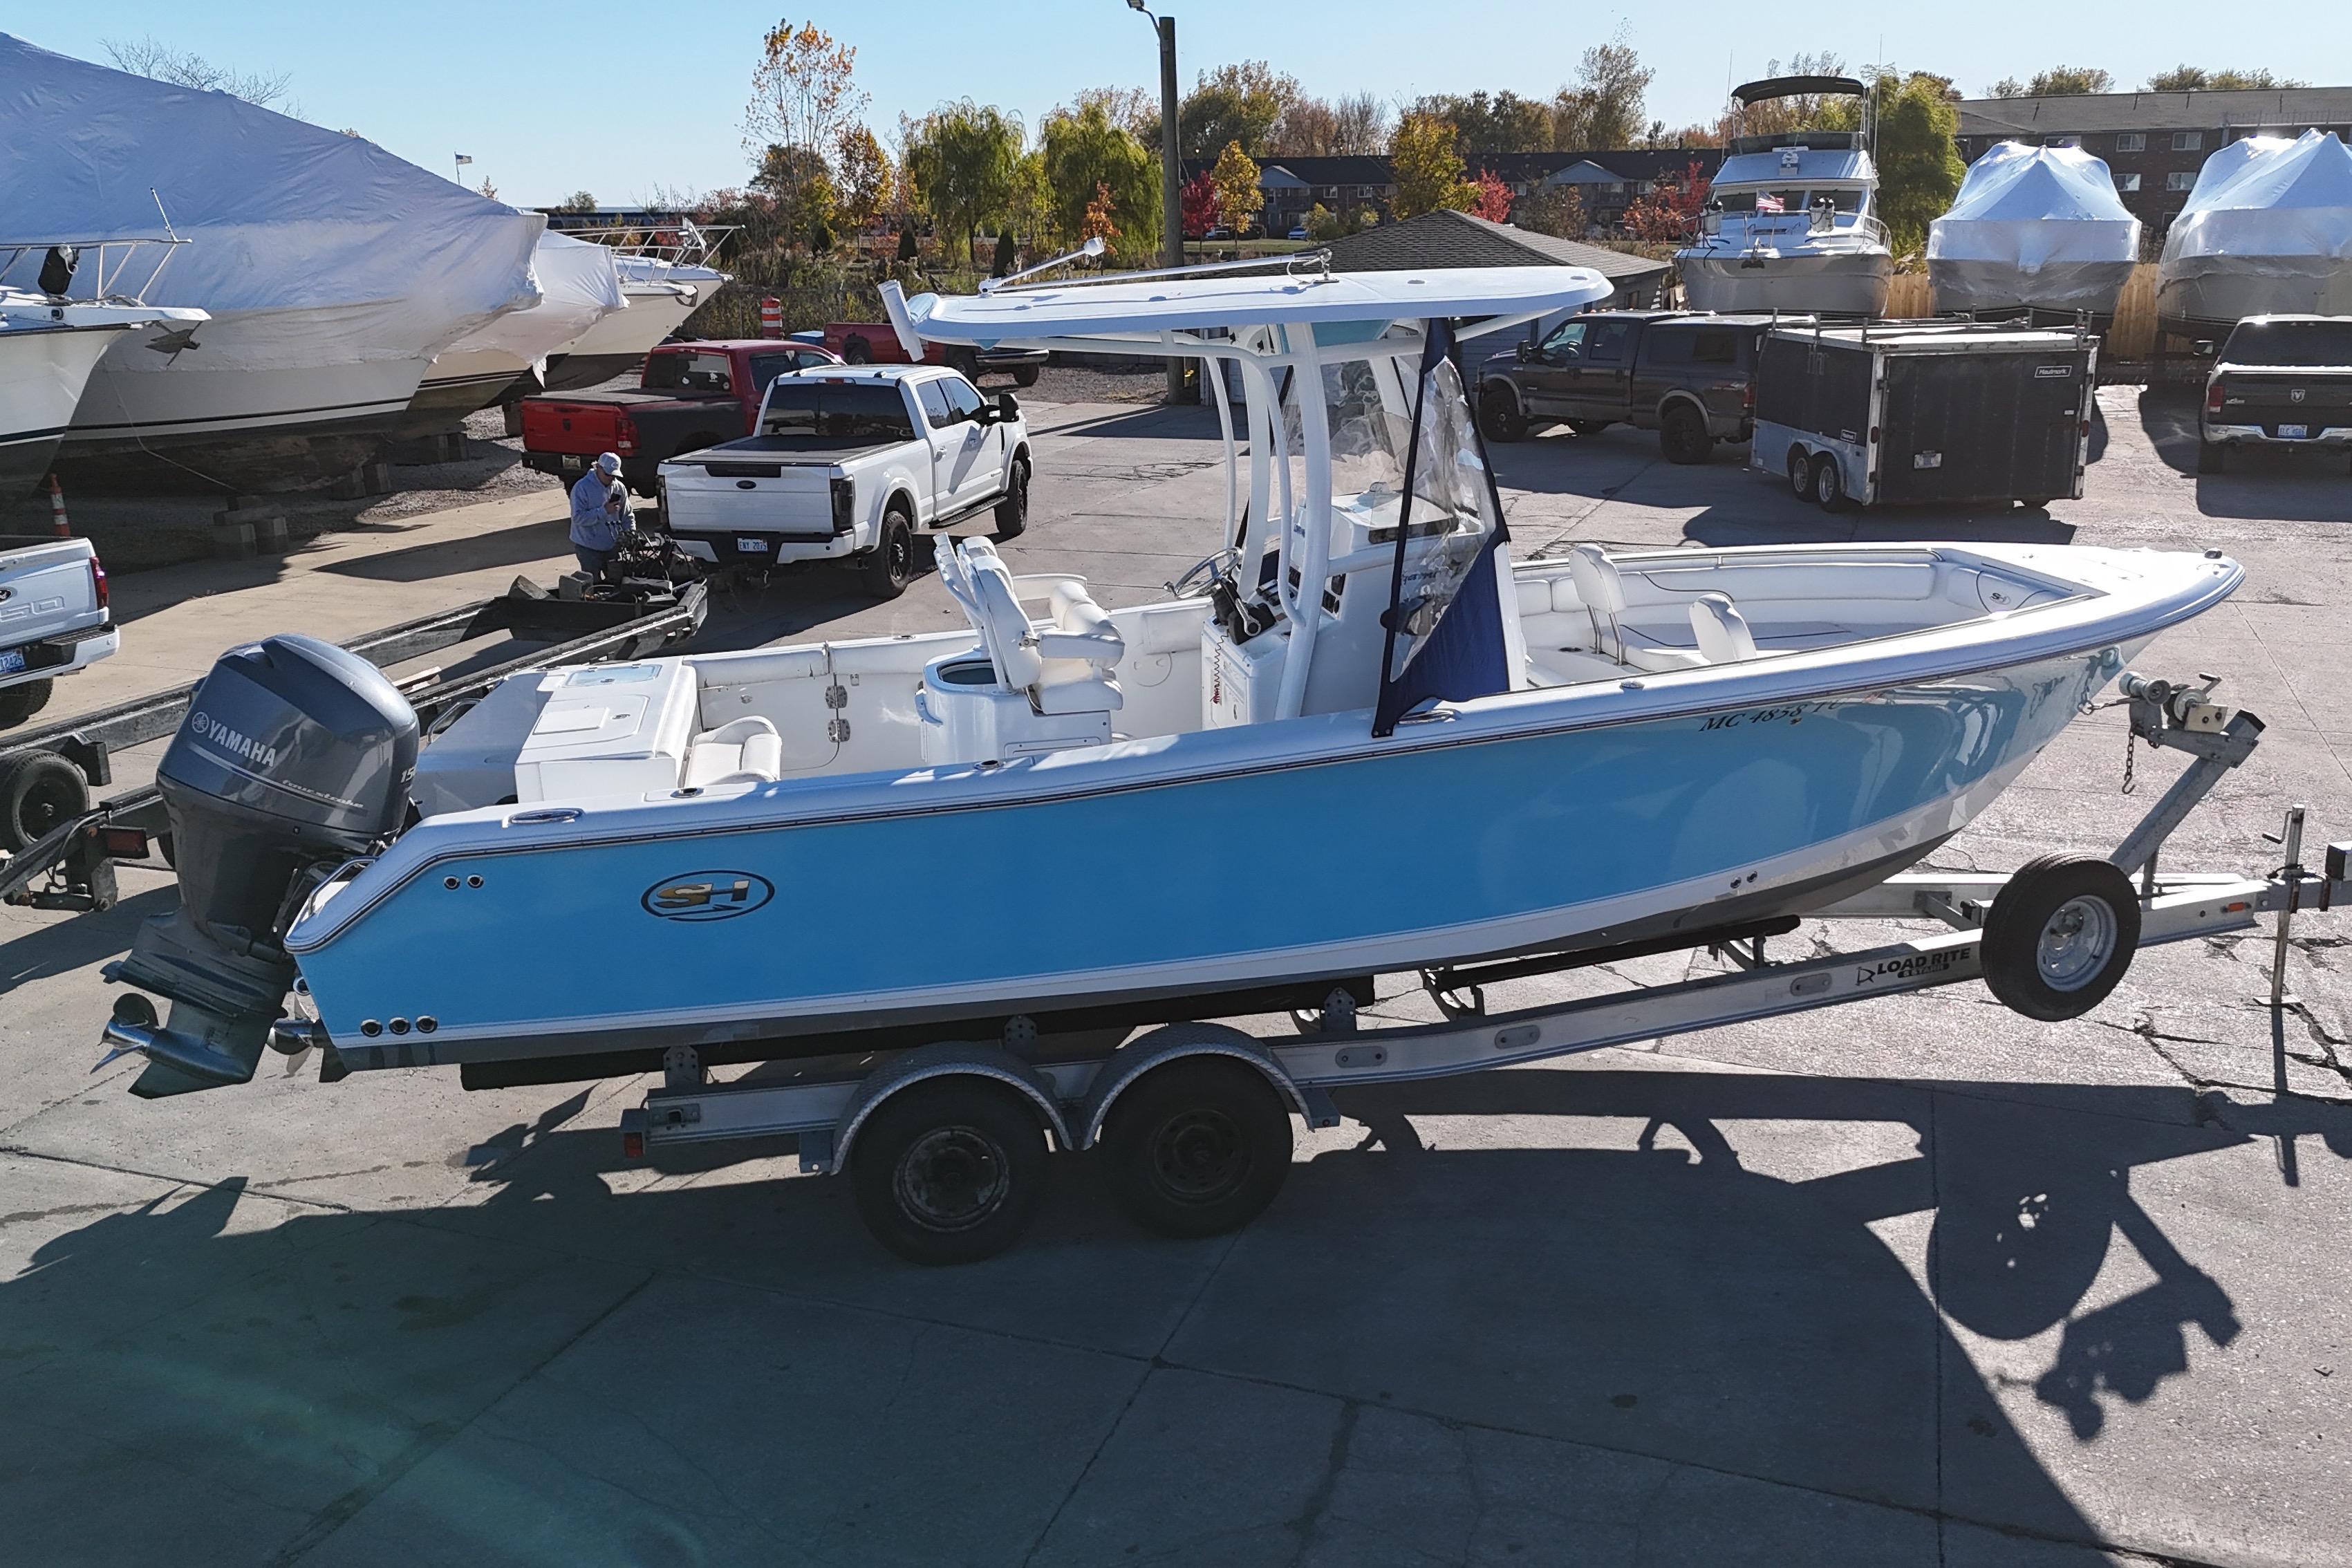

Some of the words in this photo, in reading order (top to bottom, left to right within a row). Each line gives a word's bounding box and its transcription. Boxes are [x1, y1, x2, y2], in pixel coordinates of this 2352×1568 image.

[1699, 713, 1746, 731] MC
[1748, 704, 1808, 724] 4858
[208, 720, 277, 767] YAMAHA
[400, 767, 416, 783] 15
[1877, 955, 1928, 975] LOAD
[1932, 947, 1970, 965] RITE
